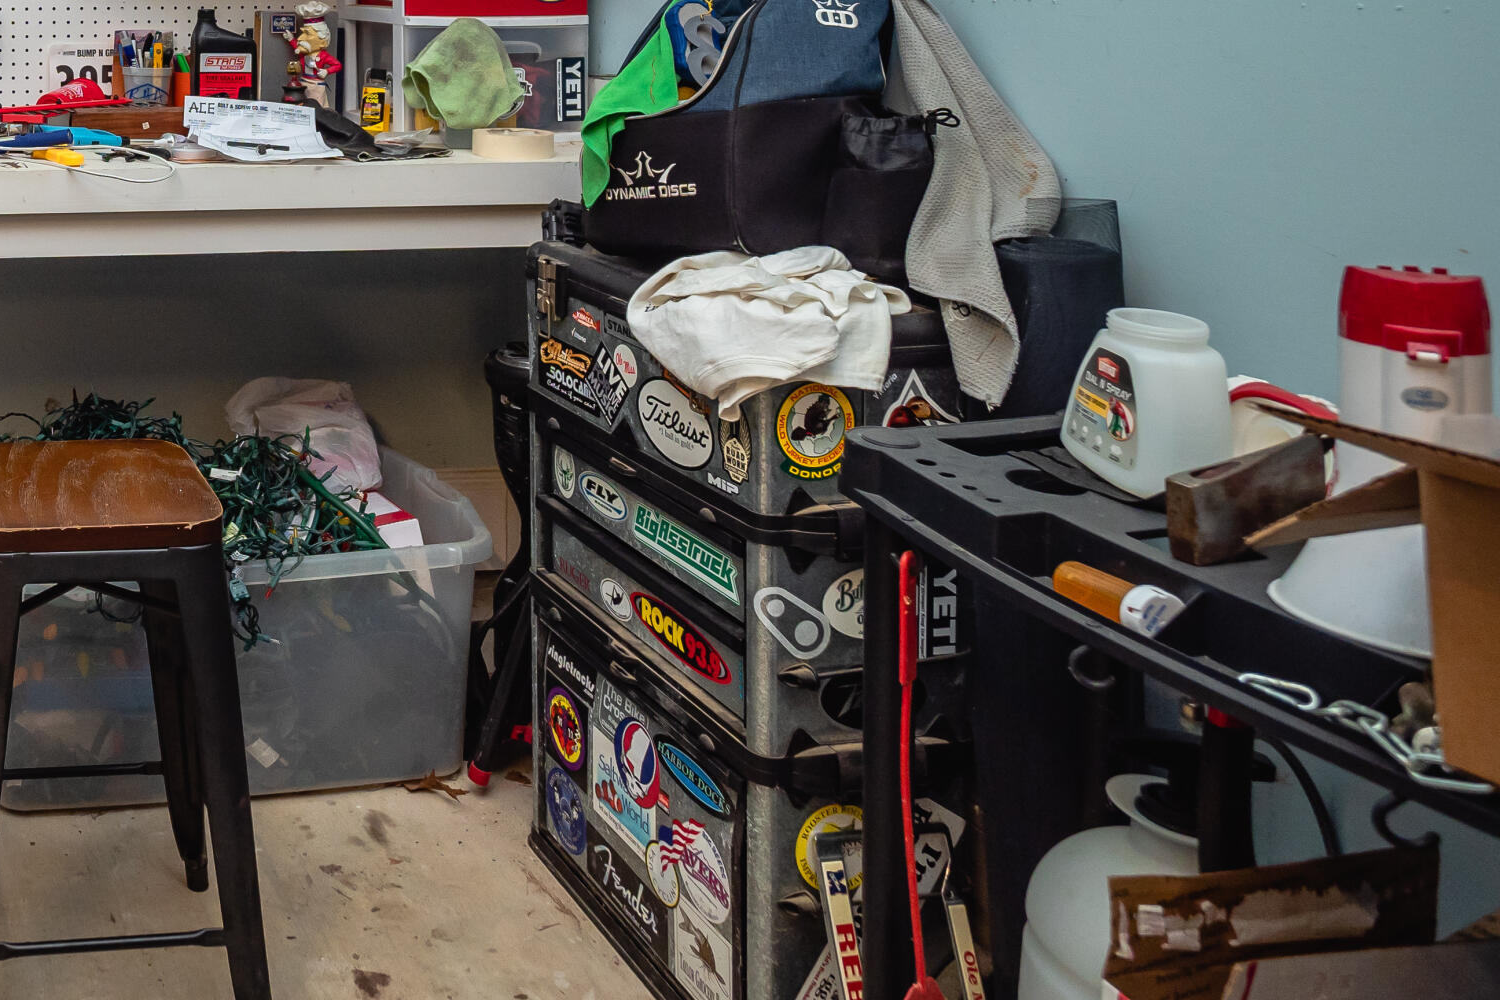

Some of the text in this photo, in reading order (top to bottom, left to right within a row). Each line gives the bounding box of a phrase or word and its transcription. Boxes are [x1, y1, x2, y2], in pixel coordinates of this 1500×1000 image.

[77, 49, 97, 57] BUMP
[565, 60, 582, 117] YETI
[189, 102, 215, 114] ACE
[606, 183, 697, 200] DYNAMIC DISCS
[790, 385, 839, 402] NATIONAL
[642, 395, 710, 448] Titleist
[779, 414, 787, 440] WILD
[783, 441, 816, 465] TURKEY
[725, 445, 745, 461] ROAD
[586, 478, 619, 504] FLY
[559, 556, 591, 592] RUGER
[933, 568, 957, 656] YETI
[641, 597, 722, 679] ROCK 93.9
[606, 680, 623, 707] The
[624, 697, 645, 726] Bike
[621, 794, 650, 836] World
[802, 807, 838, 841] ROOSTER
[594, 845, 658, 935] Fender
[964, 951, 979, 988] Ole
